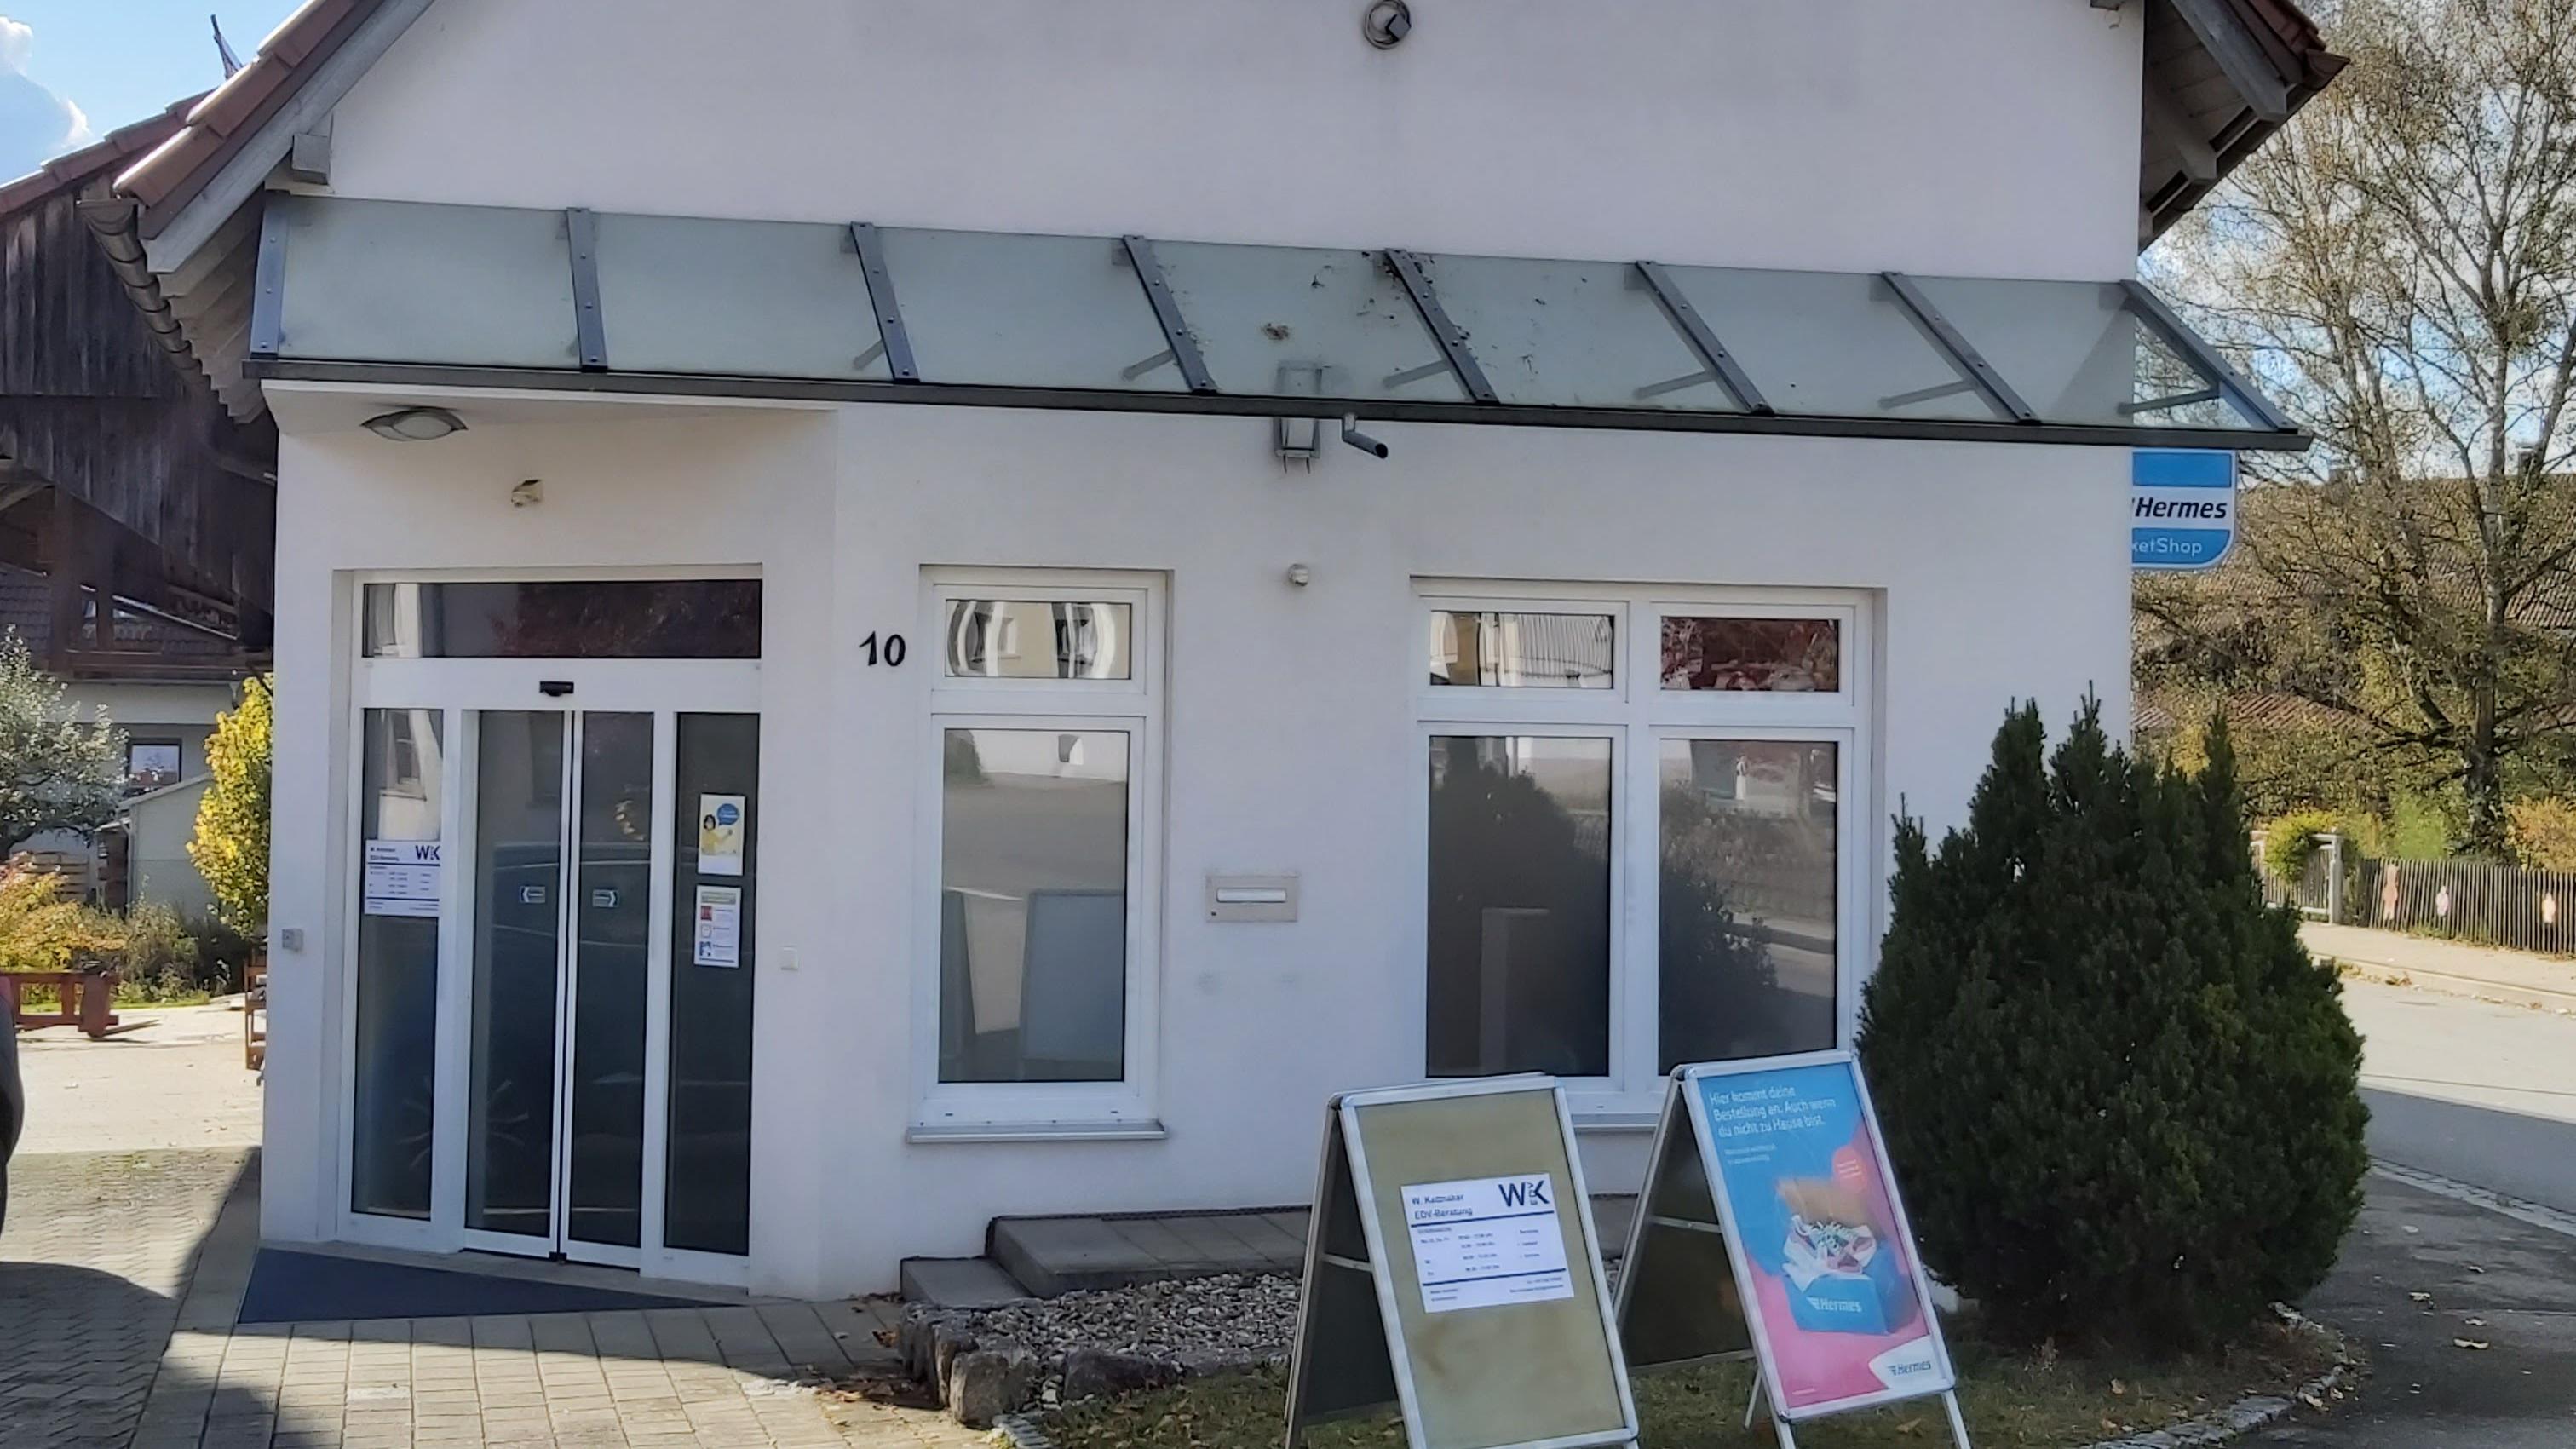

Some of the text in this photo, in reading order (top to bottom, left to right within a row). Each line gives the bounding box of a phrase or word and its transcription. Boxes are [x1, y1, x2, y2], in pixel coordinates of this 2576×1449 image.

[2135, 497, 2228, 518] Hermes
[859, 630, 906, 667] 10
[1709, 1085, 1796, 1105] Hier kommt deine
[1713, 1098, 1836, 1121] Bestellung an. Auch wenn
[1717, 1124, 1732, 1137] du
[1734, 1122, 1759, 1136] nicht
[1760, 1123, 1772, 1133] zu
[1772, 1118, 1803, 1131] Hause
[1820, 1297, 1863, 1313] Hermes
[1897, 1360, 1932, 1376] Hermes
